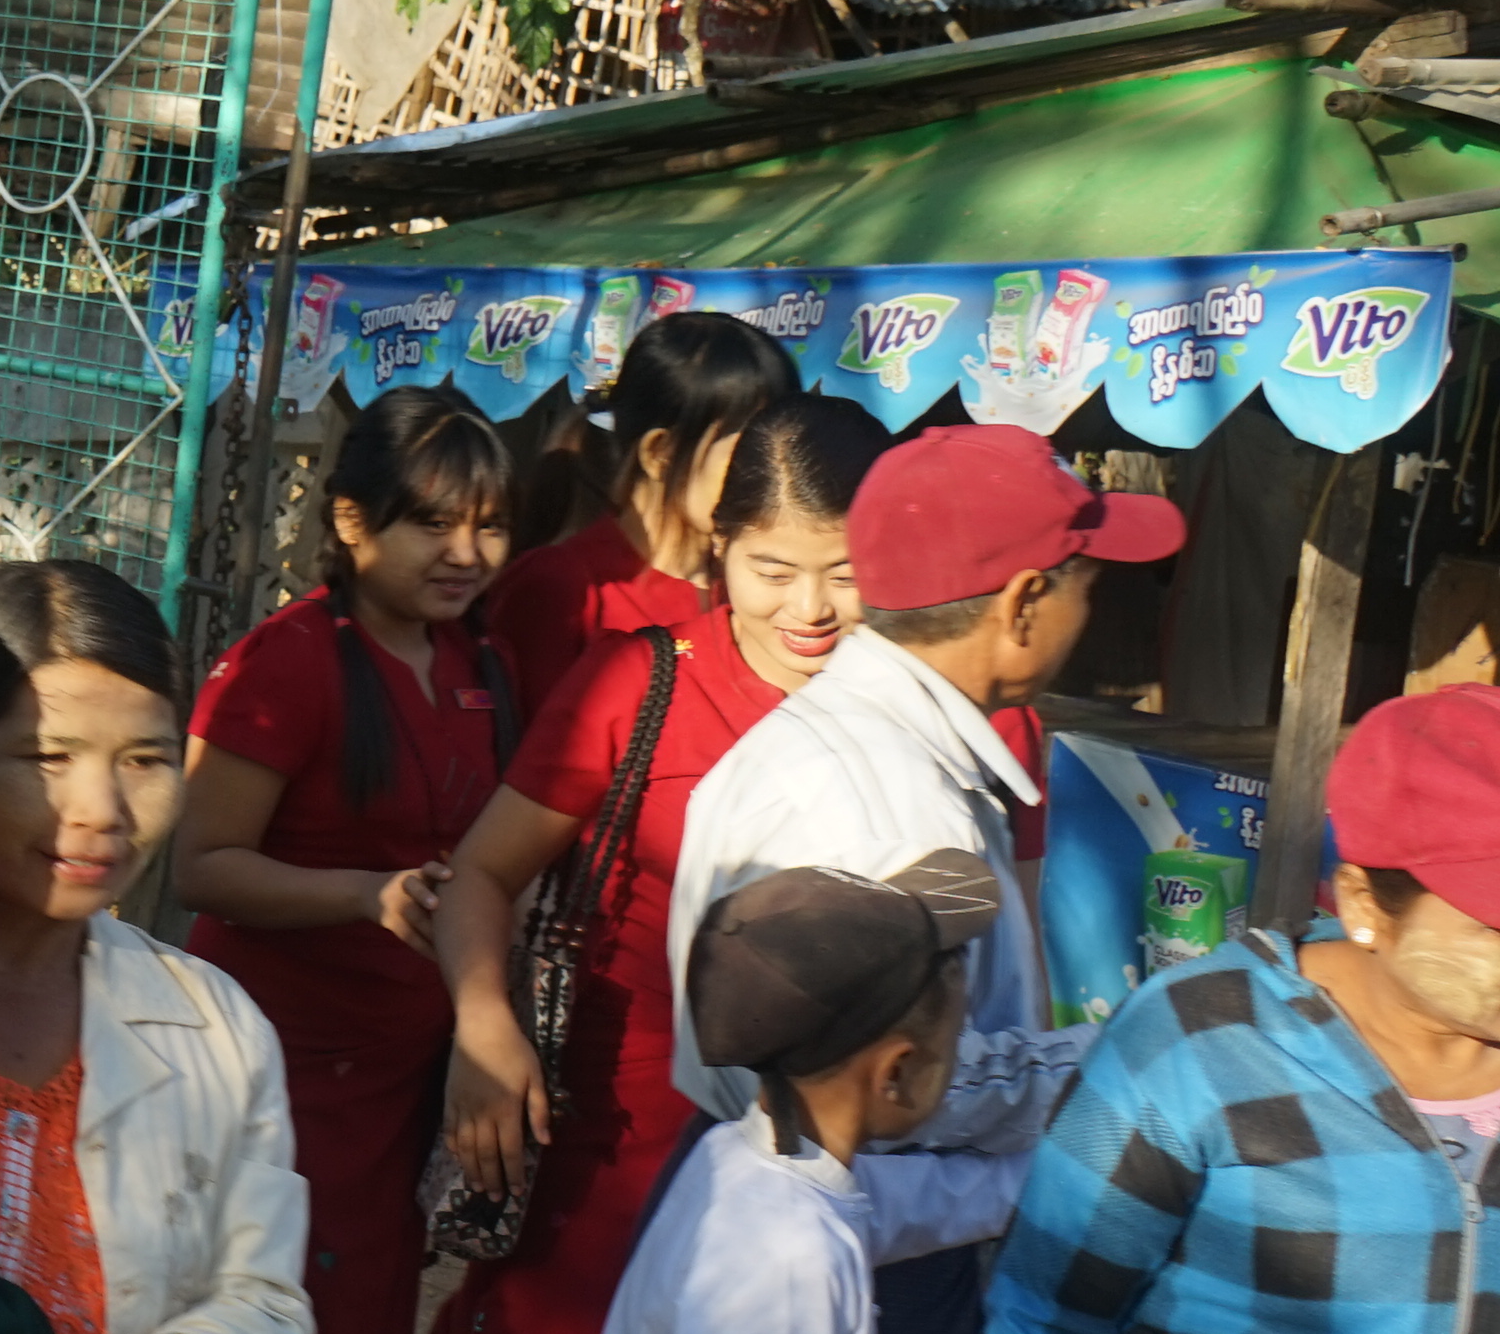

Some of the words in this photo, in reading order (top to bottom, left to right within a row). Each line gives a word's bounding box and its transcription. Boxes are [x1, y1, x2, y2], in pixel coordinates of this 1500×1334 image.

[482, 306, 551, 356] Vito
[859, 305, 935, 364] Vito
[1308, 300, 1406, 365] Vito
[1155, 876, 1203, 906] Vito
